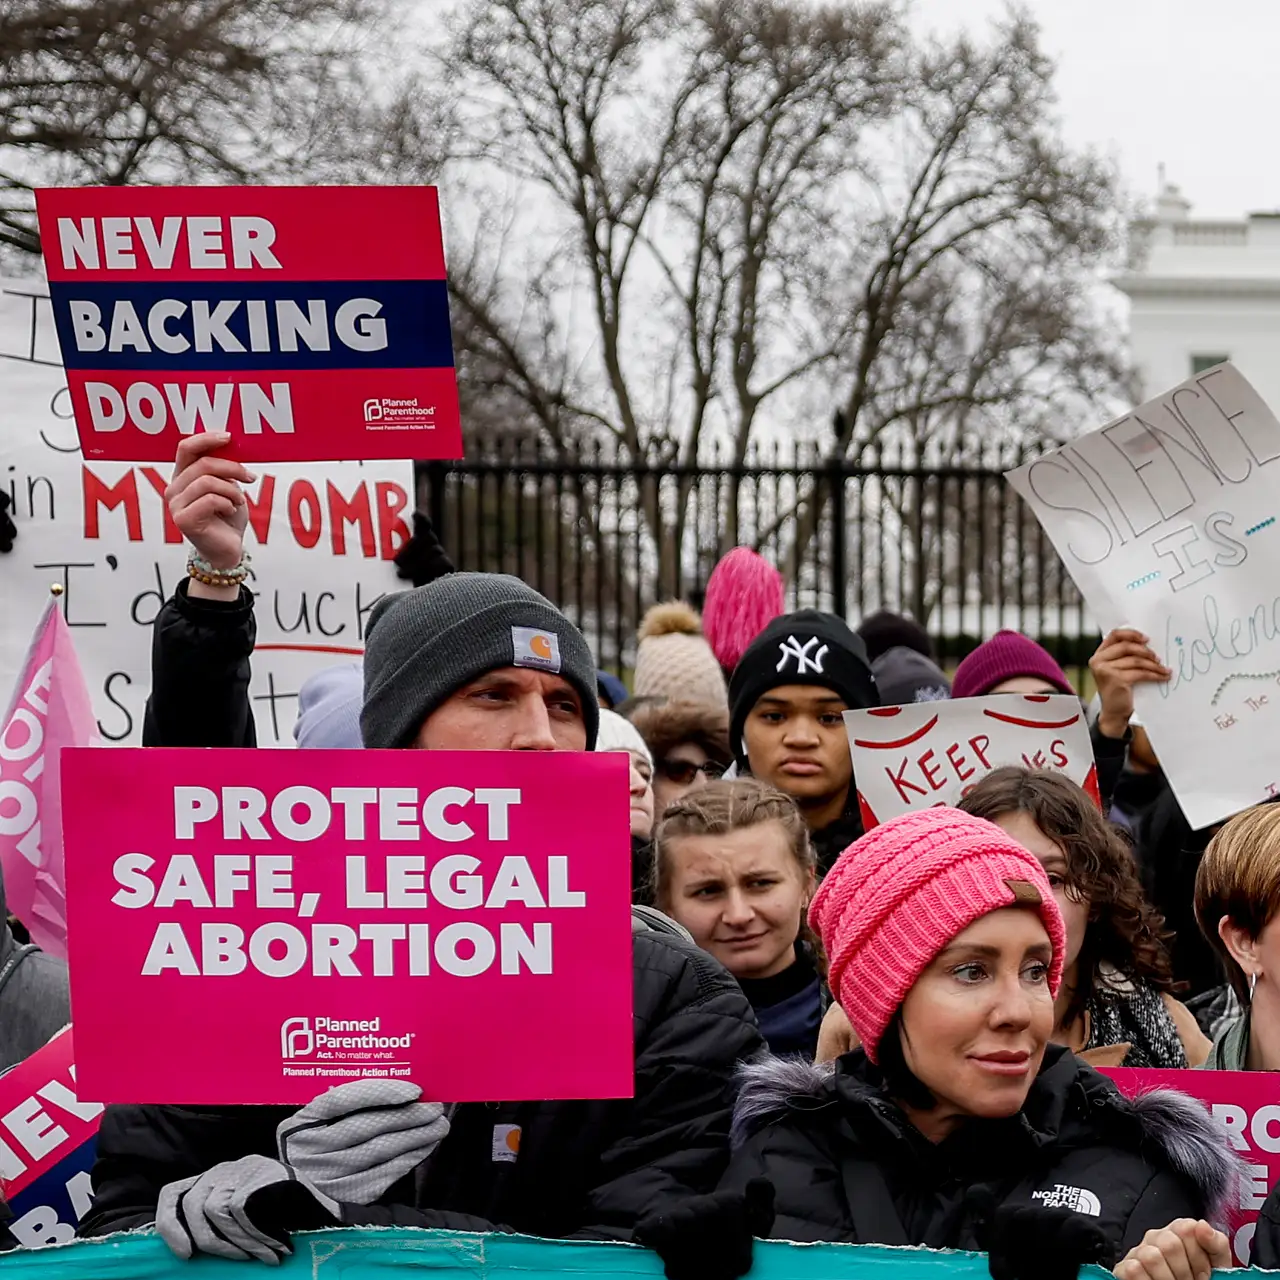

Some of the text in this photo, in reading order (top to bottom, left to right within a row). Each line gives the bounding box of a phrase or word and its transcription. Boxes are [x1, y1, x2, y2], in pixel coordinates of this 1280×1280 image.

[57, 216, 283, 270] NEVER
[69, 297, 389, 354] BACKING
[84, 381, 295, 434] DOWN
[382, 398, 418, 406] Planned
[8, 466, 54, 519] in
[1151, 511, 1248, 593] IS
[884, 733, 993, 805] KEEP
[174, 785, 521, 842] PROTECT
[111, 853, 586, 917] SAFE, LEGAL
[141, 922, 553, 977] ABORTION
[315, 1017, 380, 1031] Planned
[283, 1067, 411, 1076] Planned Parenthood Action Fund
[317, 1051, 334, 1059] Act.
[335, 1051, 346, 1059] No
[347, 1051, 371, 1059] matter
[1032, 1190, 1078, 1203] NORTH
[1043, 1198, 1077, 1209] FACE
[1054, 1184, 1080, 1196] THE
